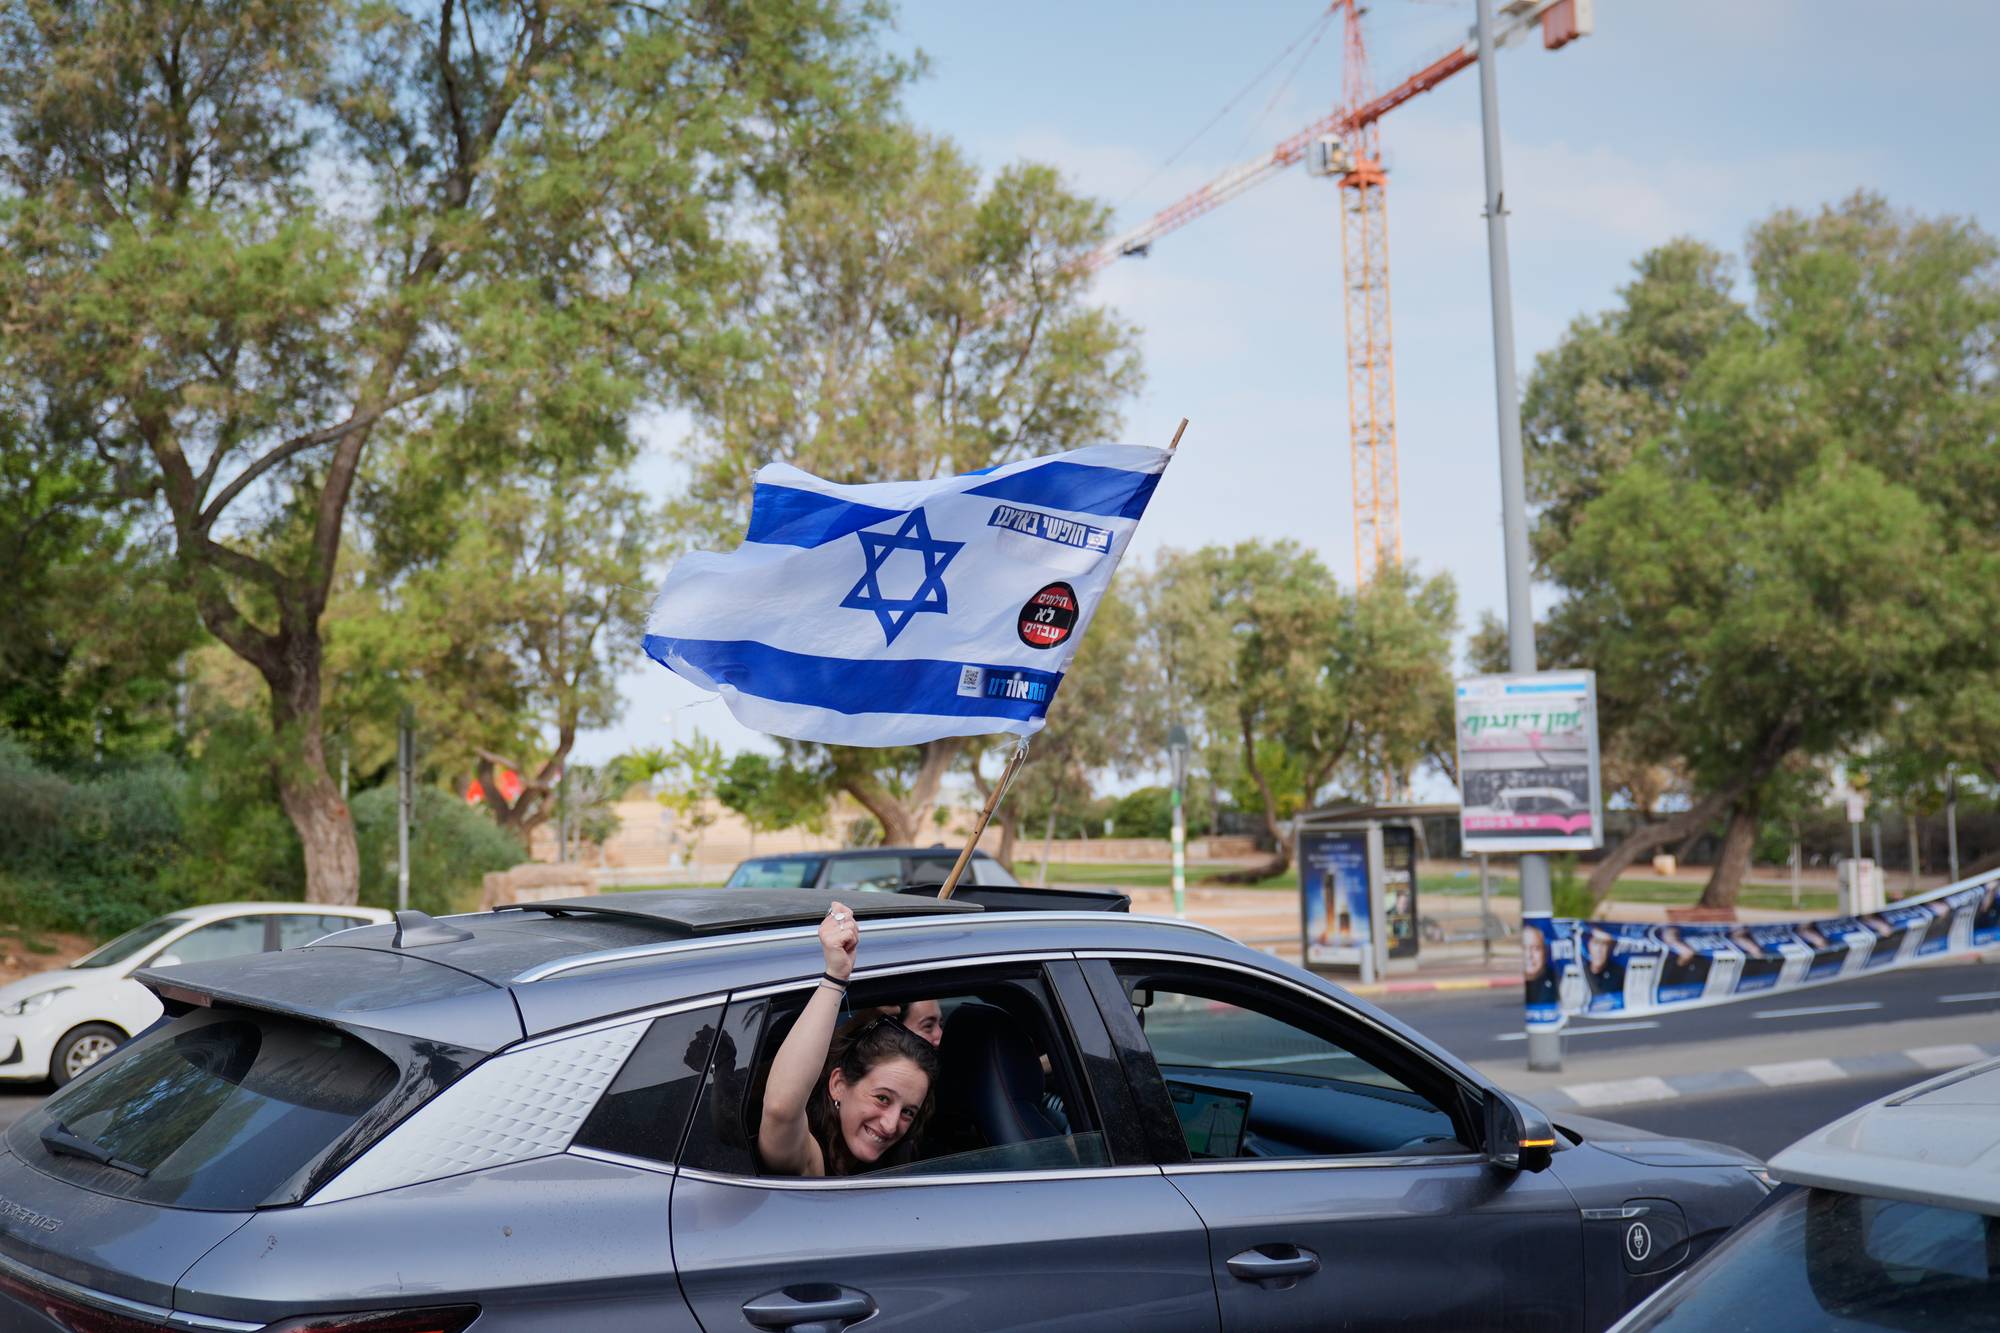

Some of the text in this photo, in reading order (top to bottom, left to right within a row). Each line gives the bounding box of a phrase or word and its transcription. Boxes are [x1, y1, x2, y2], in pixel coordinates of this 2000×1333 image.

[993, 506, 1088, 547] חופשי בארצנו
[1038, 593, 1069, 608] חילונים
[1034, 606, 1056, 623] לא
[1023, 622, 1060, 639] עבדים
[1466, 713, 1541, 737] דיזנגוף
